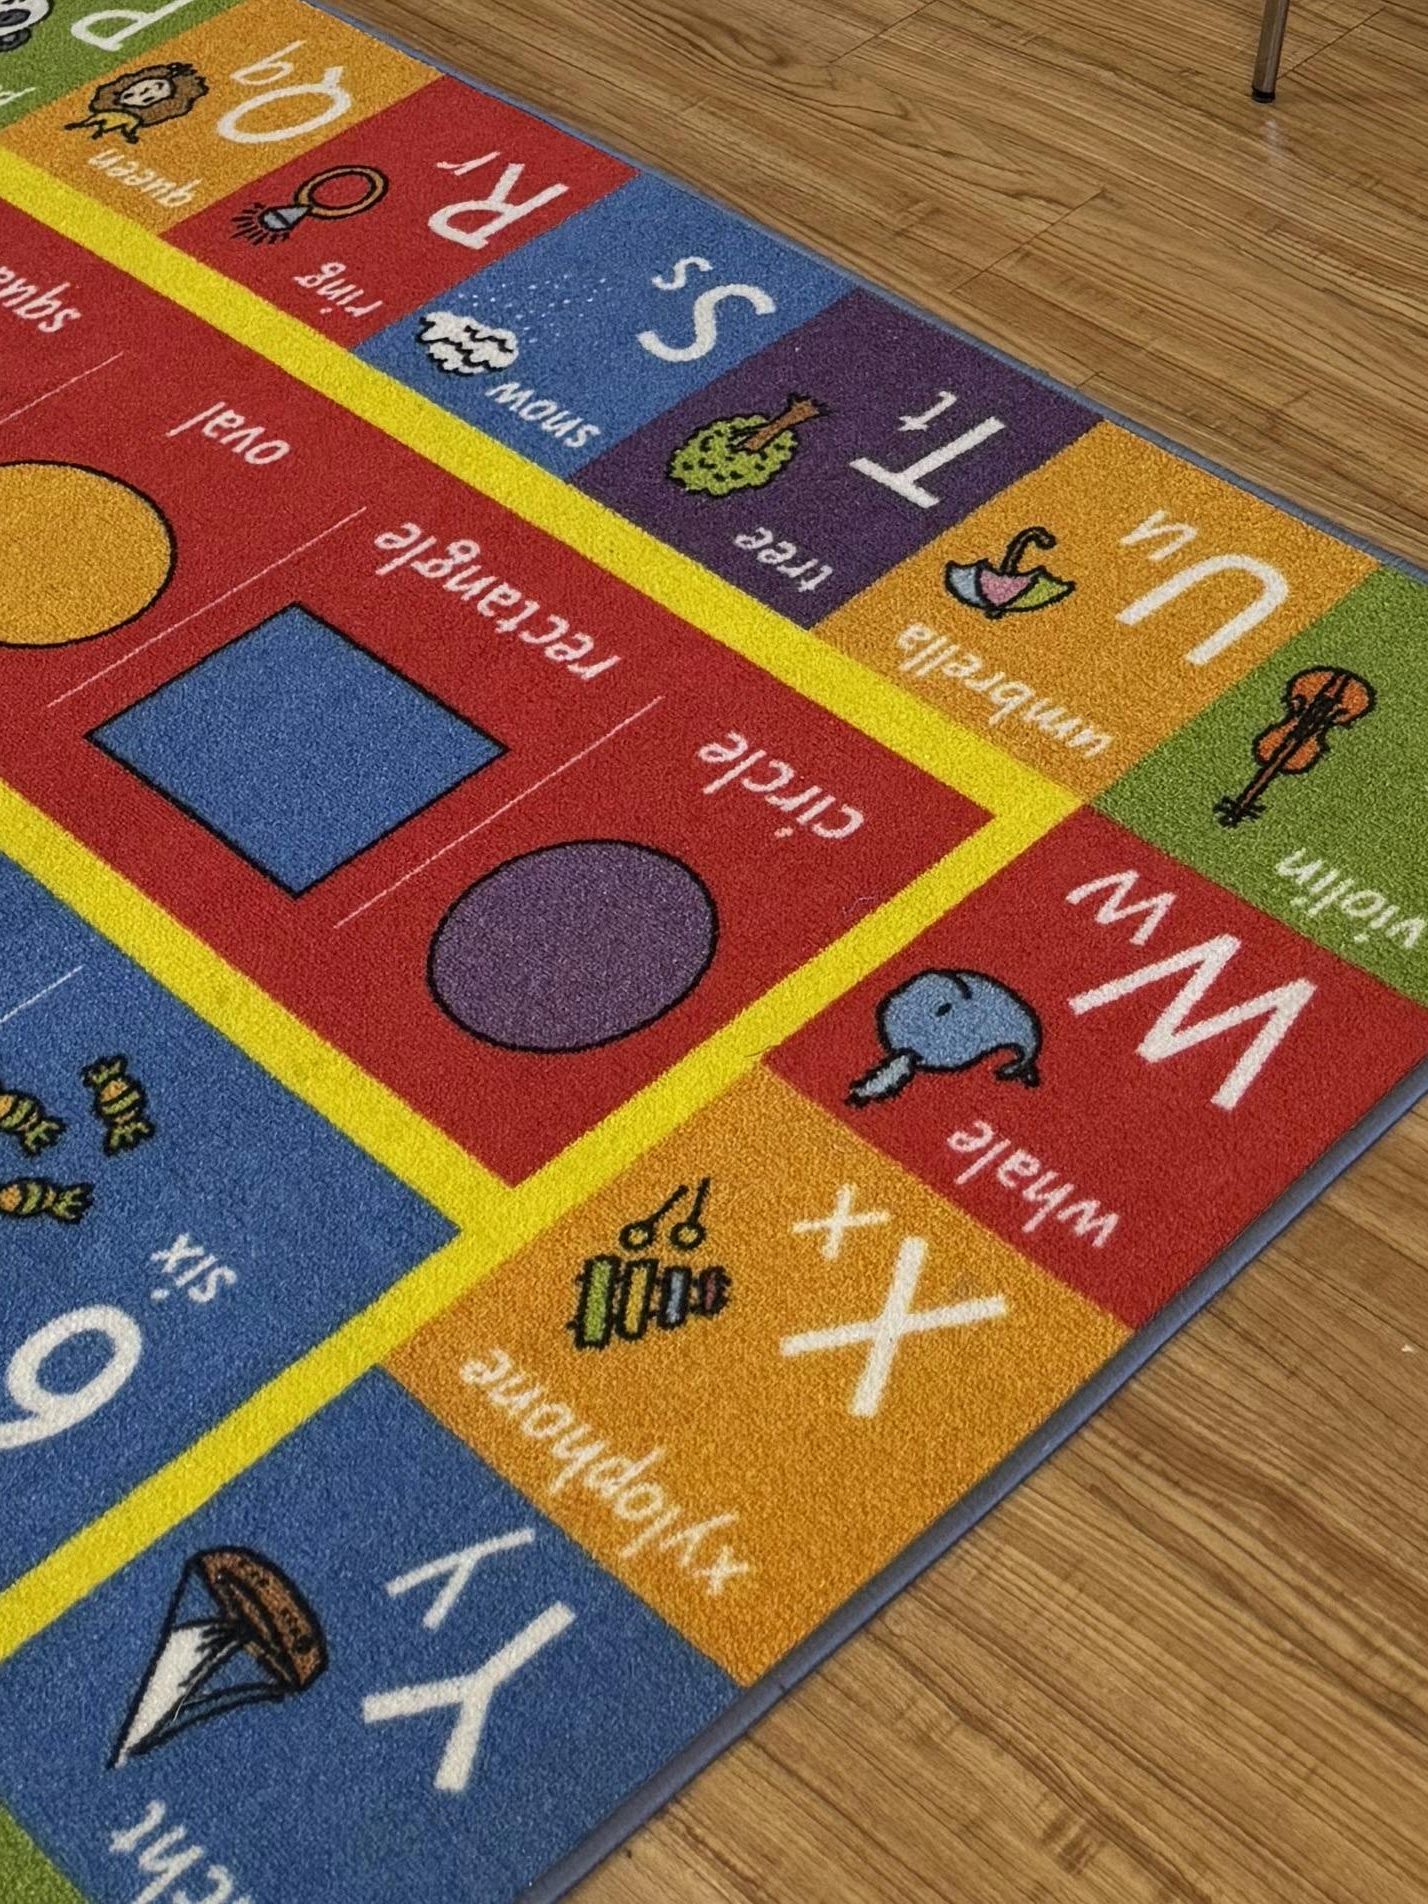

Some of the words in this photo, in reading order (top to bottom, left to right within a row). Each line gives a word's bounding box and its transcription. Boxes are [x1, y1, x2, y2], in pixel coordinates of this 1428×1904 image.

[87, 148, 202, 208] queen
[293, 261, 383, 318] ring
[166, 401, 290, 465] oval
[485, 381, 601, 448] snow
[373, 522, 621, 681] rectangle
[734, 526, 833, 593] tree
[897, 622, 1114, 758] umbrella
[698, 731, 865, 839] circle
[1274, 847, 1428, 949] violin
[946, 1120, 1119, 1248] whale
[150, 1232, 237, 1303] six
[455, 1348, 760, 1596] xylophone
